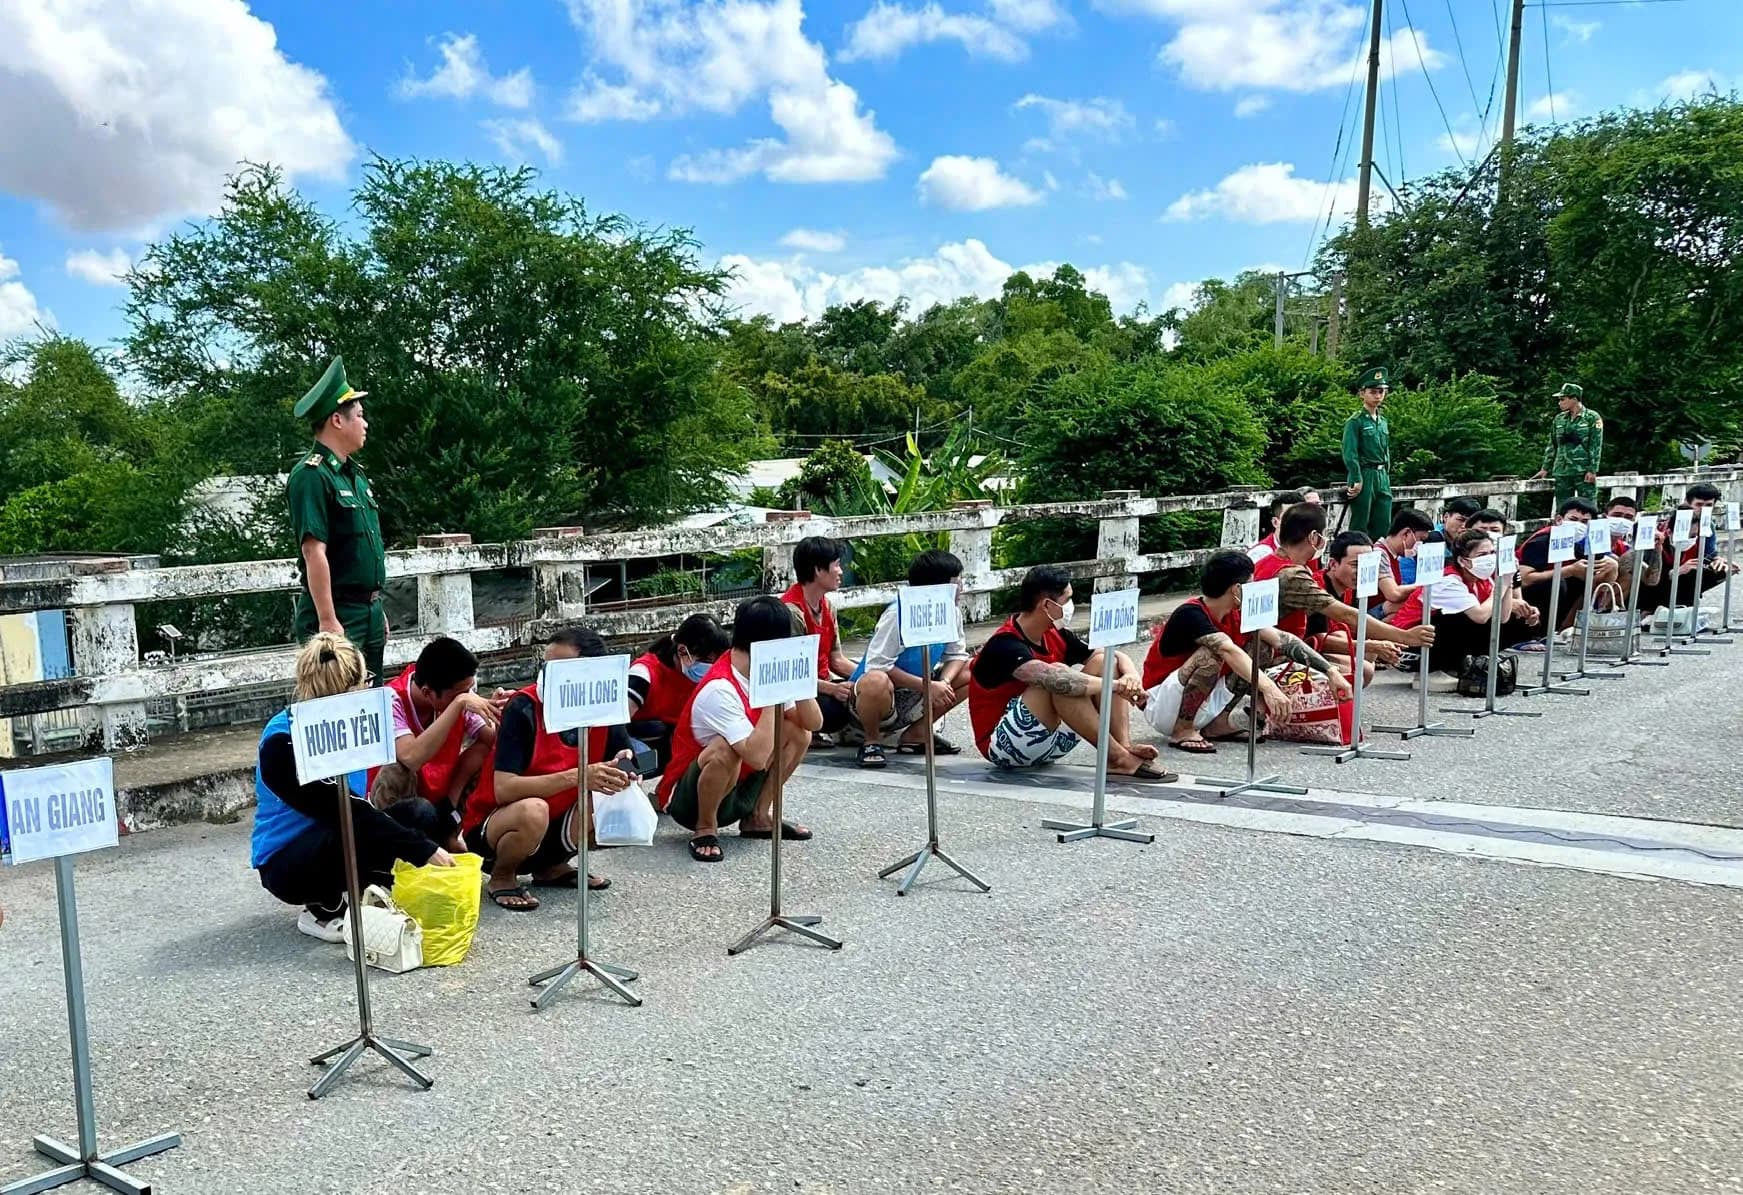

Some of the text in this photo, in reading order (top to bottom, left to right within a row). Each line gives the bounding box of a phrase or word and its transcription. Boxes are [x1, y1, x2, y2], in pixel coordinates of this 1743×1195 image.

[910, 599, 947, 632] NGHỆ AN
[1093, 605, 1112, 632] LÂM
[758, 651, 810, 686] KHÁNH HÒA
[559, 679, 618, 708] VĨNH LONG
[305, 708, 381, 757] HƯNG YÊN
[11, 787, 106, 835] AN GIANG
